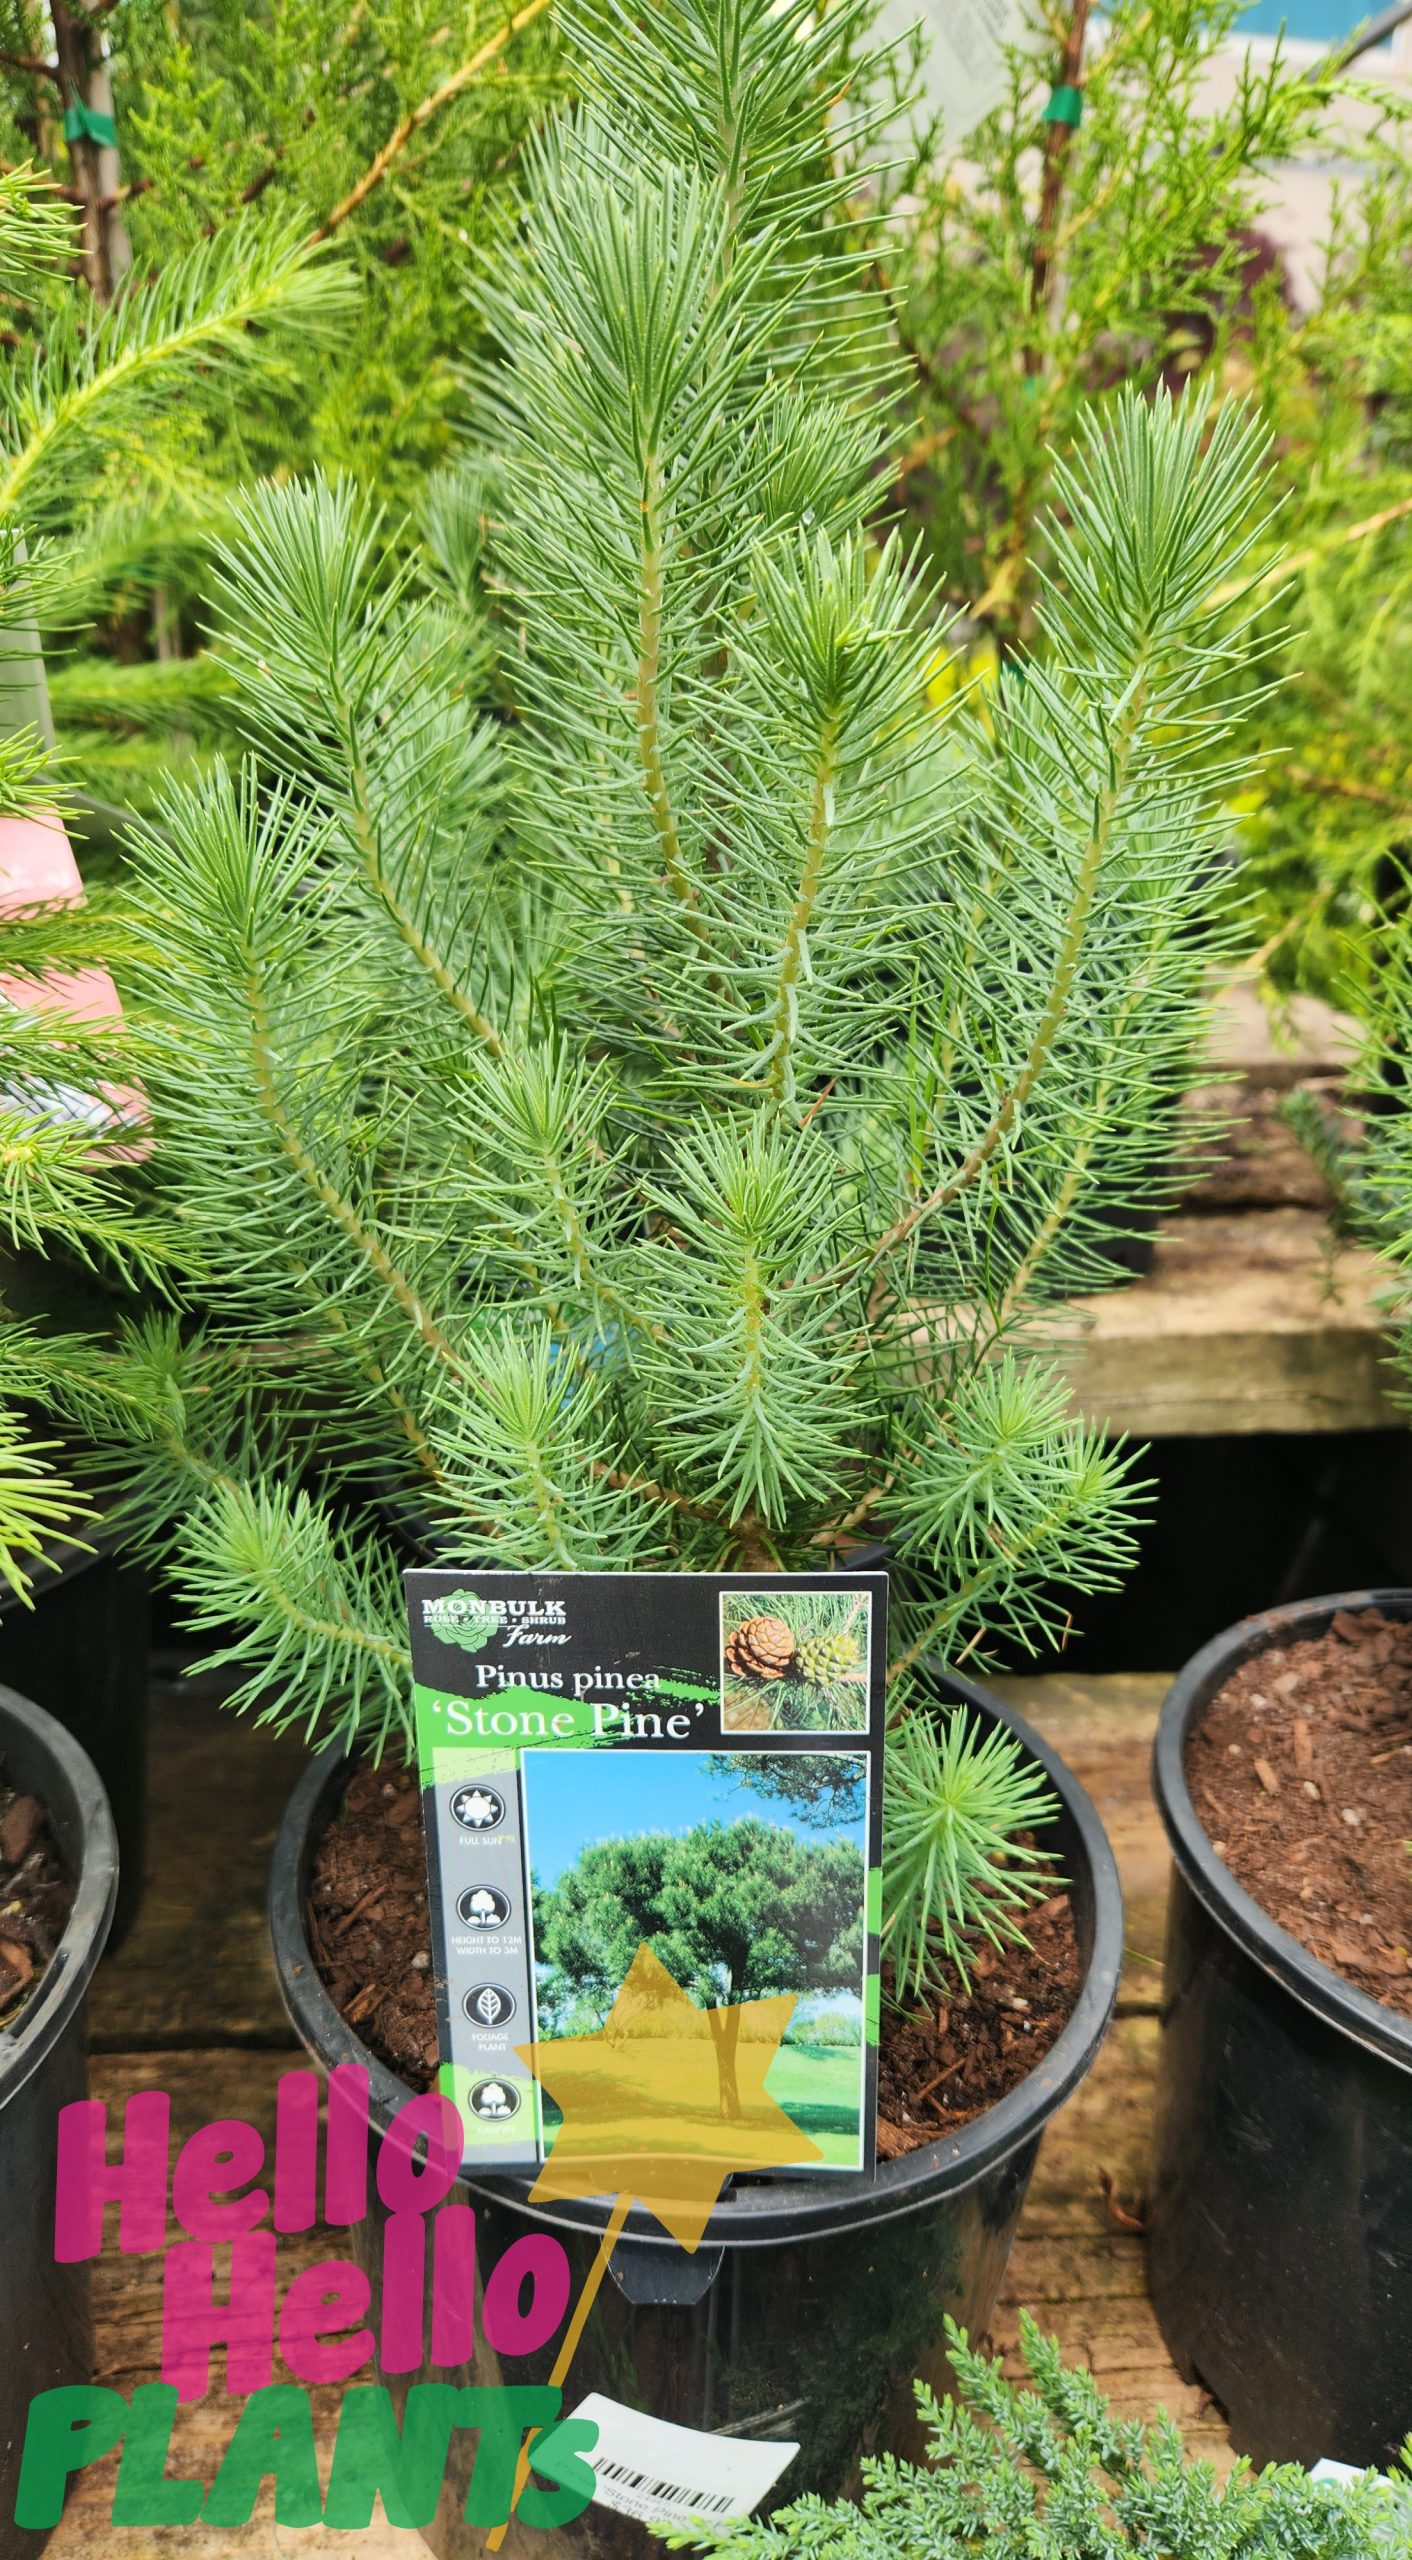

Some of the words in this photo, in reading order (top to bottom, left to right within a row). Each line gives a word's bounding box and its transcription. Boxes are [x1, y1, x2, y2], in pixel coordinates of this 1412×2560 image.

[421, 1599, 567, 1616] MONBULK
[424, 1615, 459, 1624] ROSE
[474, 1615, 508, 1625] TREE
[521, 1616, 567, 1625] SHRUB
[502, 1624, 572, 1648] Farm
[475, 1664, 564, 1689] Pinus
[572, 1665, 661, 1697] pinea
[459, 1836, 480, 1845] FULL
[481, 1836, 502, 1845] SUN
[451, 1935, 484, 1945] HEIGHT
[486, 1935, 500, 1944] TO
[502, 1935, 522, 1945] 12M
[456, 1946, 487, 1955] WIDTH
[489, 1946, 502, 1955] TO
[503, 1946, 519, 1955] 3M
[472, 2032, 509, 2042] FOLIAGE
[478, 2042, 507, 2052] PLANT
